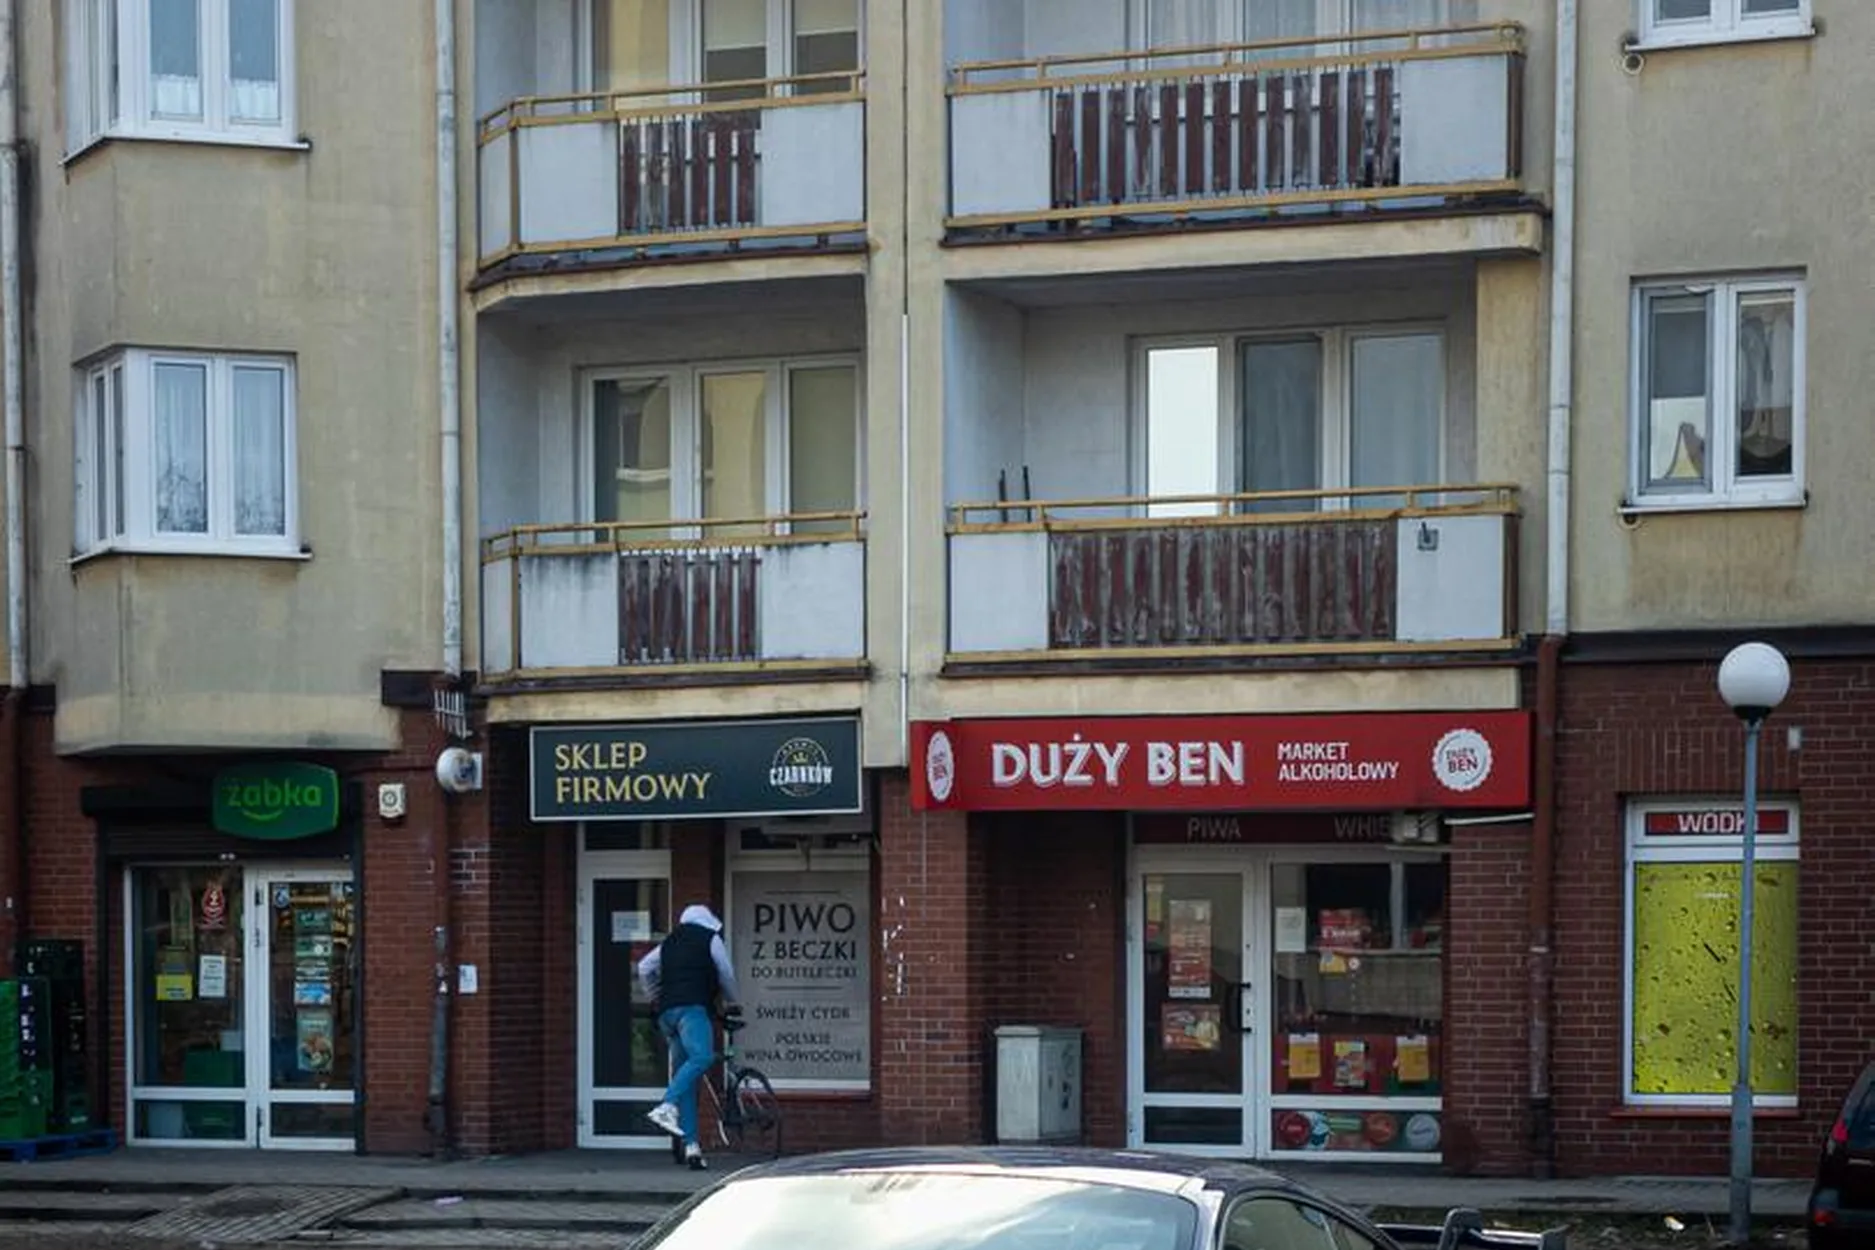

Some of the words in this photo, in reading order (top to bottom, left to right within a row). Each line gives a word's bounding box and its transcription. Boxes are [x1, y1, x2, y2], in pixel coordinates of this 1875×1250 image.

[555, 741, 647, 771] SKLEP
[991, 732, 1130, 788] DUŻY
[1147, 741, 1245, 787] BEN
[1277, 742, 1349, 760] MARKET
[1279, 762, 1399, 781] ALKOHOLOWY
[556, 772, 712, 804] FIRMOWY
[1187, 816, 1242, 839] PIWA
[754, 903, 855, 934] PIWO
[751, 941, 766, 960] Z
[775, 941, 856, 960] BECZKI
[751, 966, 773, 979] DO
